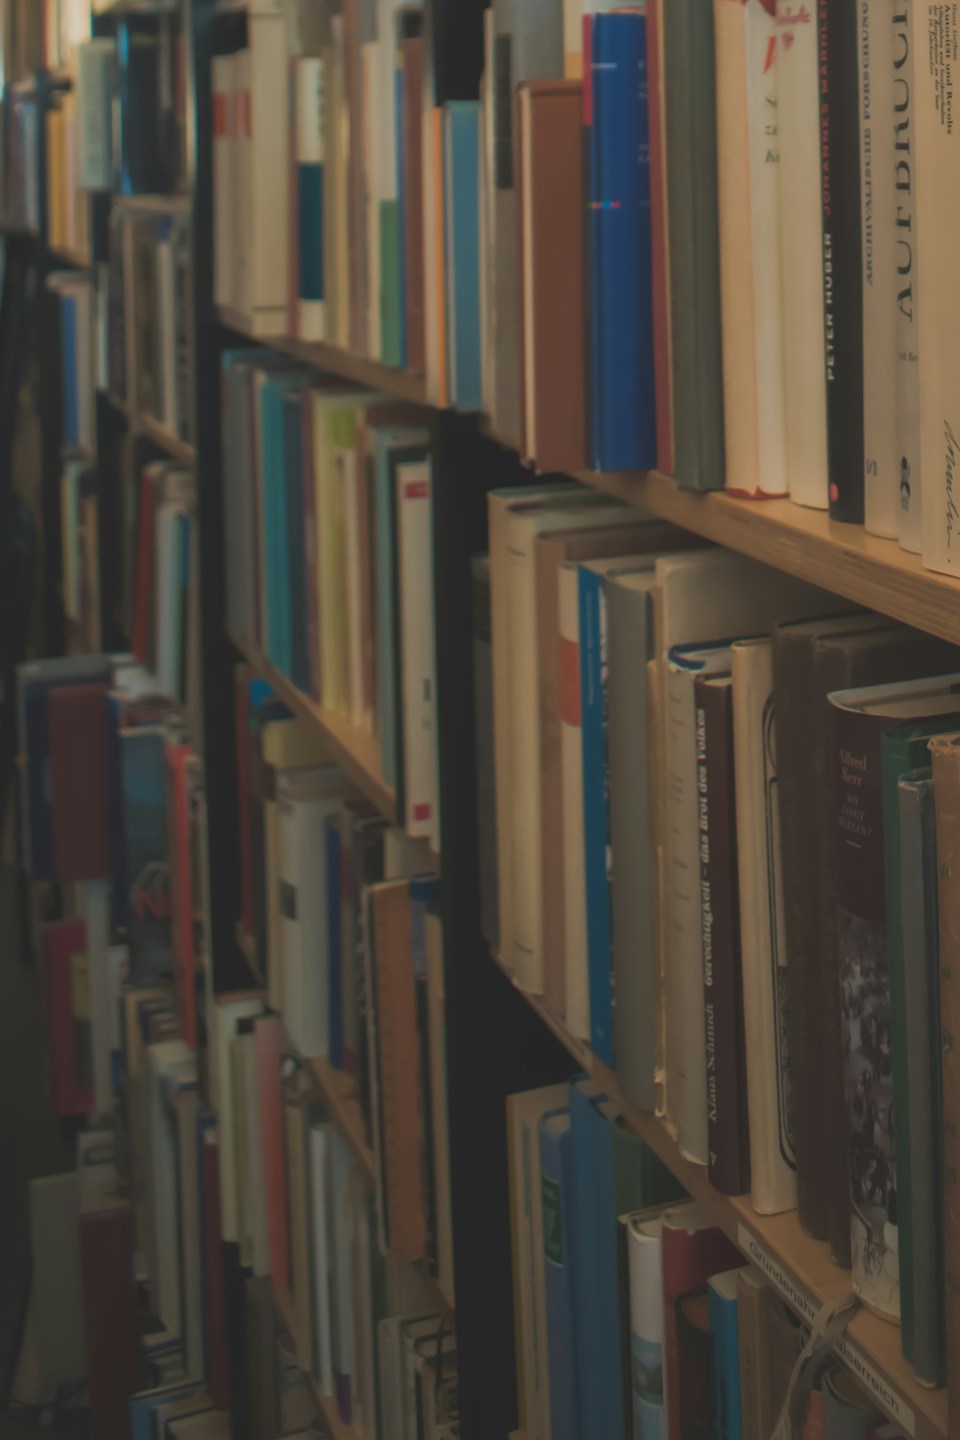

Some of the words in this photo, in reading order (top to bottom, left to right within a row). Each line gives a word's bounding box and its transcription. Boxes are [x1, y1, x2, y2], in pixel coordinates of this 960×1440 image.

[945, 64, 953, 86] und
[946, 91, 954, 135] Revolte
[821, 103, 830, 217] JOHANNES
[864, 128, 873, 287] ARCHIVALISCHE
[823, 233, 832, 304] HUBER
[825, 313, 834, 381] PETER
[697, 765, 708, 793] des
[833, 1336, 901, 1414] aiserreich
